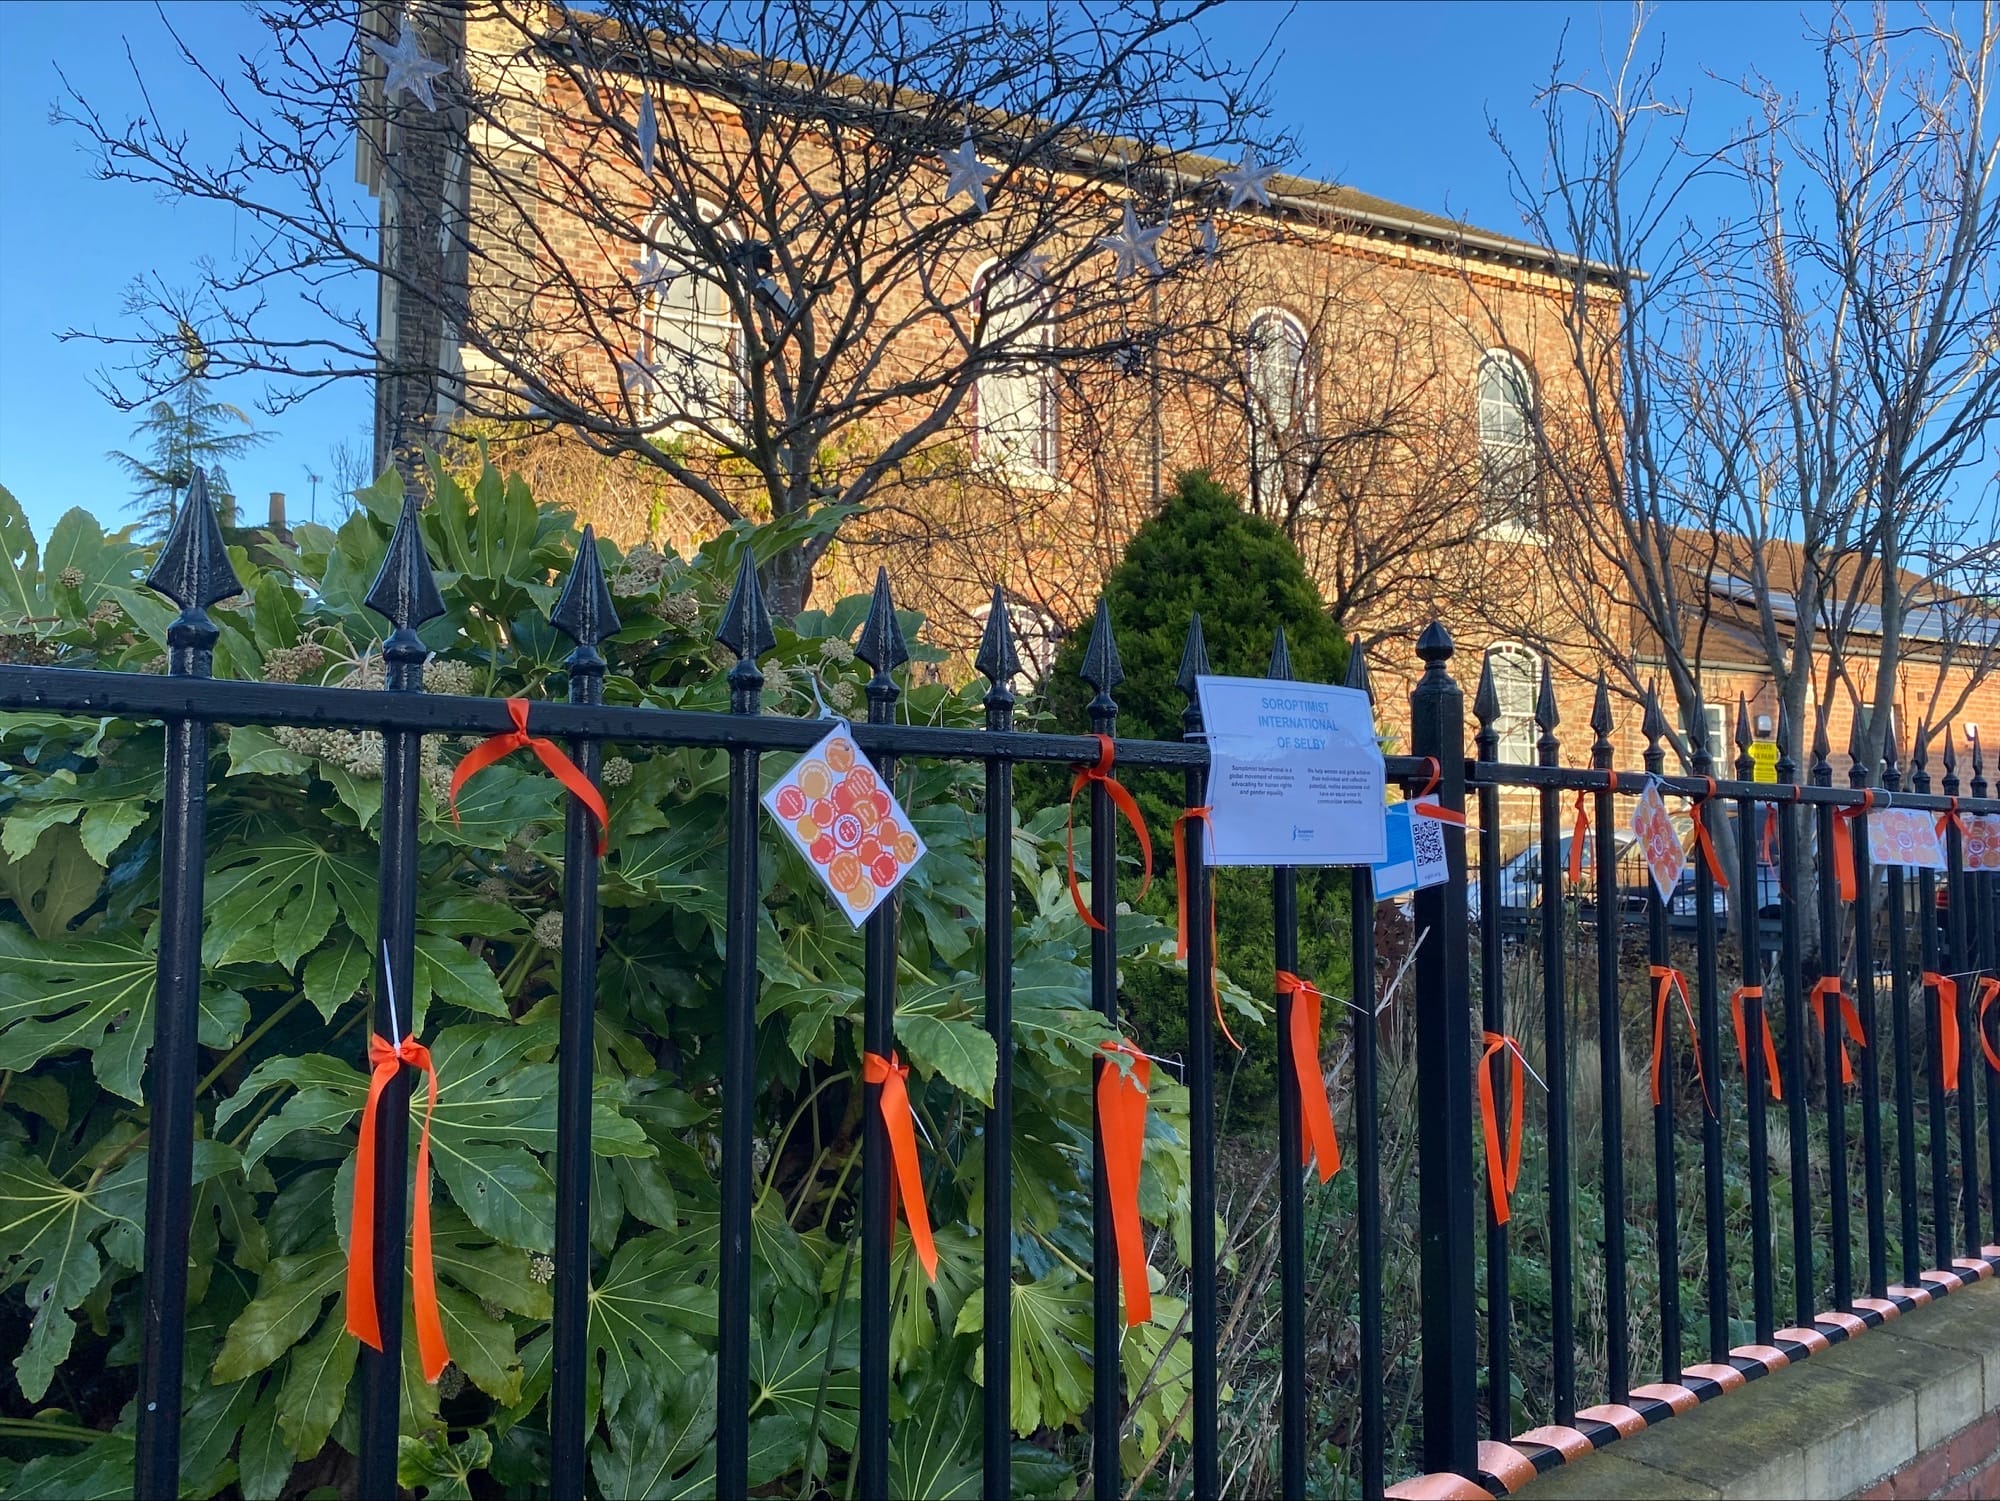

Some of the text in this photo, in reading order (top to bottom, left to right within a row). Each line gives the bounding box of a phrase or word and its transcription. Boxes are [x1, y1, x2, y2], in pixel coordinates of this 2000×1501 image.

[1262, 698, 1329, 713] SOROPTIMIST
[1258, 715, 1339, 731] INTERNATIONAL
[1277, 736, 1326, 750] OF SELBY
